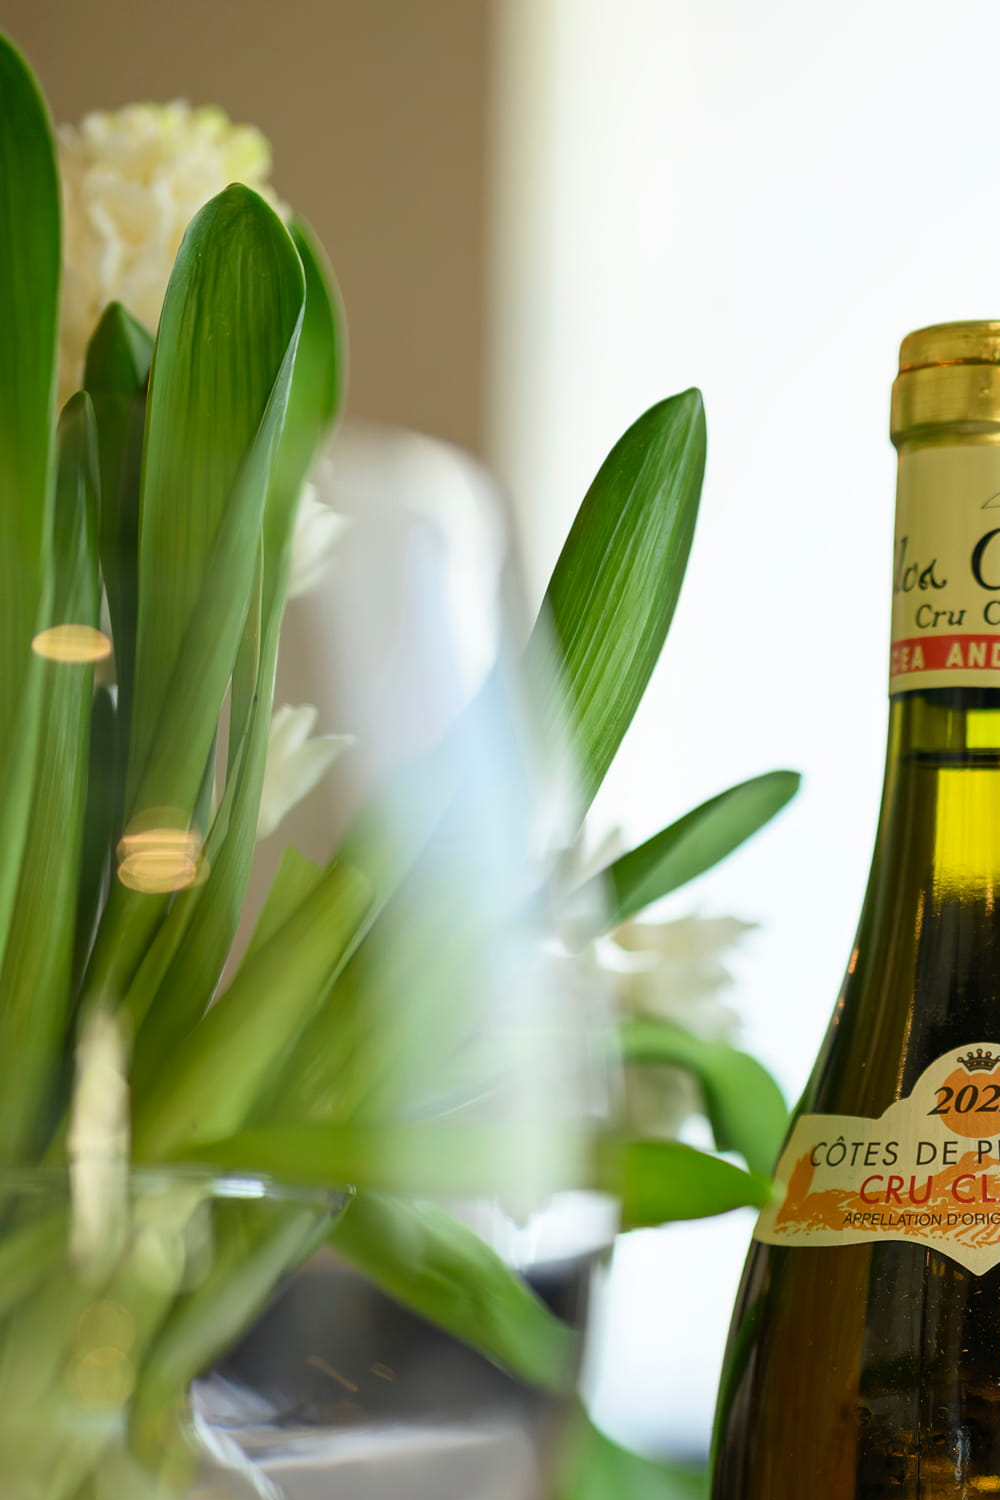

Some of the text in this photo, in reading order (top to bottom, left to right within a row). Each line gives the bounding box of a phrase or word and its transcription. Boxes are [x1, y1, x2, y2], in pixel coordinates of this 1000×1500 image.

[916, 603, 966, 629] Cru
[810, 1135, 899, 1168] CÔTES
[916, 1141, 958, 1166] DE
[860, 1174, 932, 1205] CRU
[842, 1211, 940, 1227] APPELLATION
